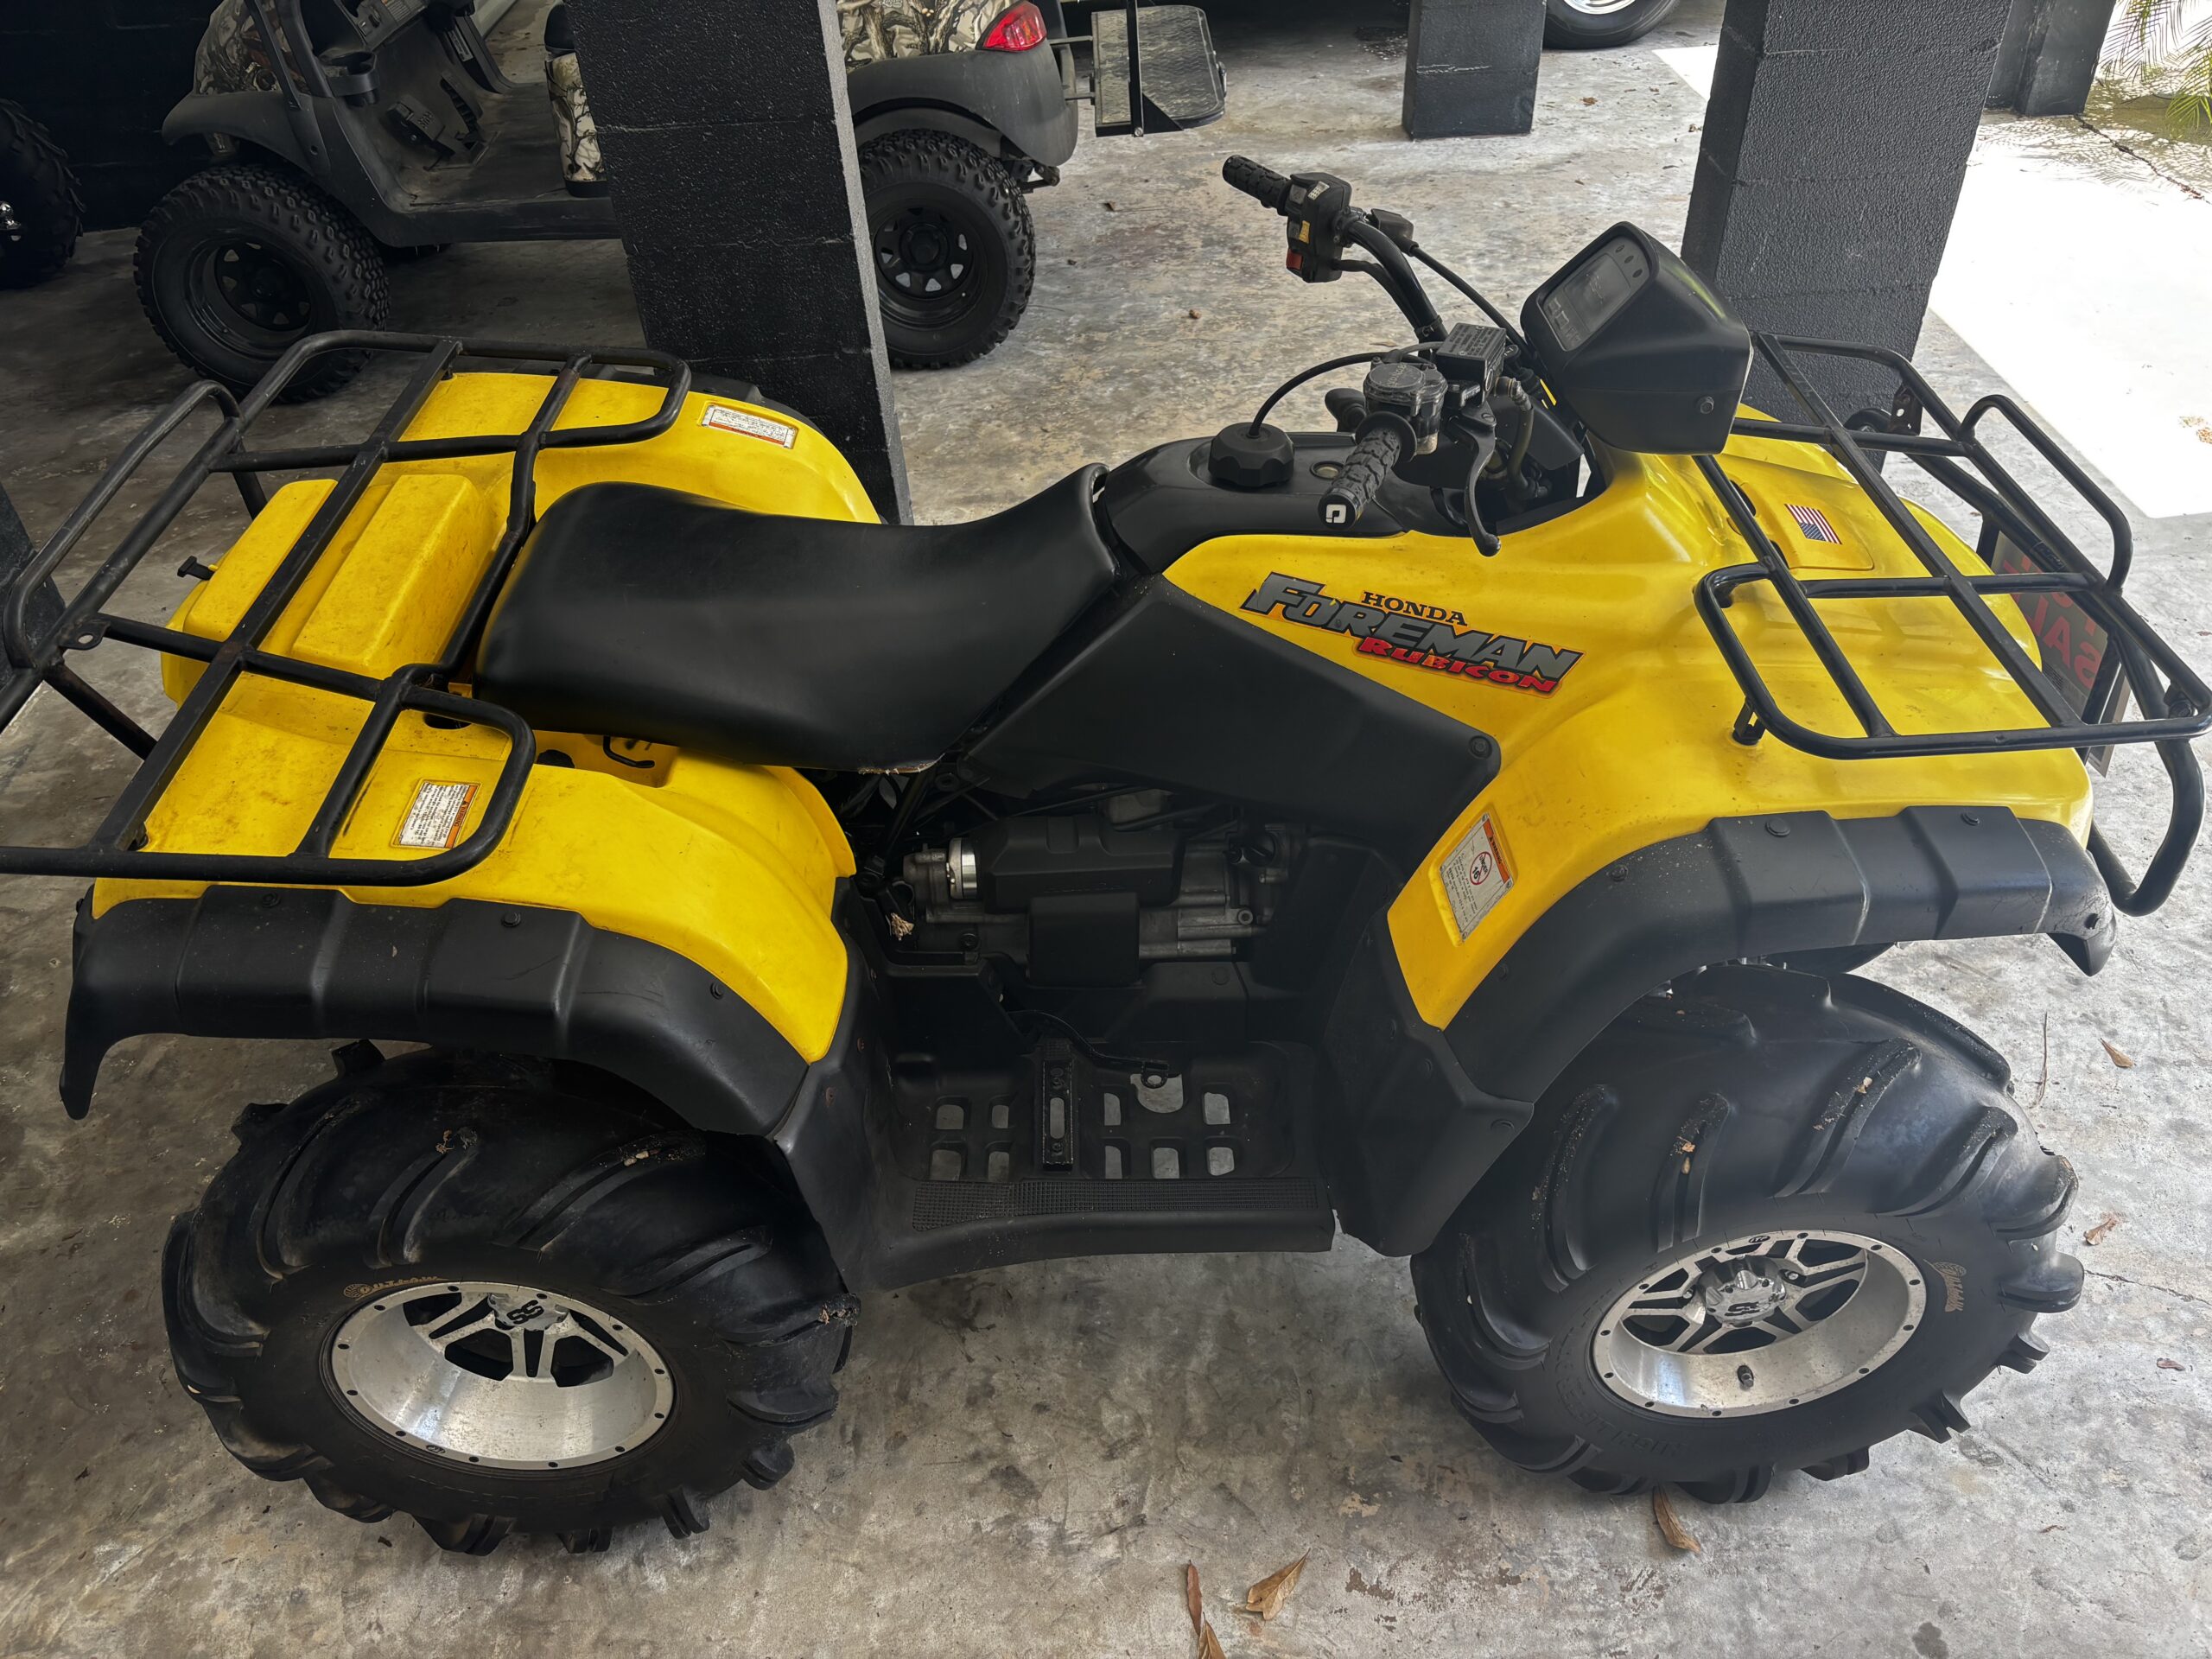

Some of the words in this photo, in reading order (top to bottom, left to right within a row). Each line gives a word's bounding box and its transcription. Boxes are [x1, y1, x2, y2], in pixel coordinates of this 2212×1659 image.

[1361, 591, 1468, 626] HONDA
[1241, 571, 1584, 682] FOREMAN
[1358, 636, 1559, 693] RUBICON
[1472, 867, 1480, 880] 16
[507, 1300, 545, 1325] SS
